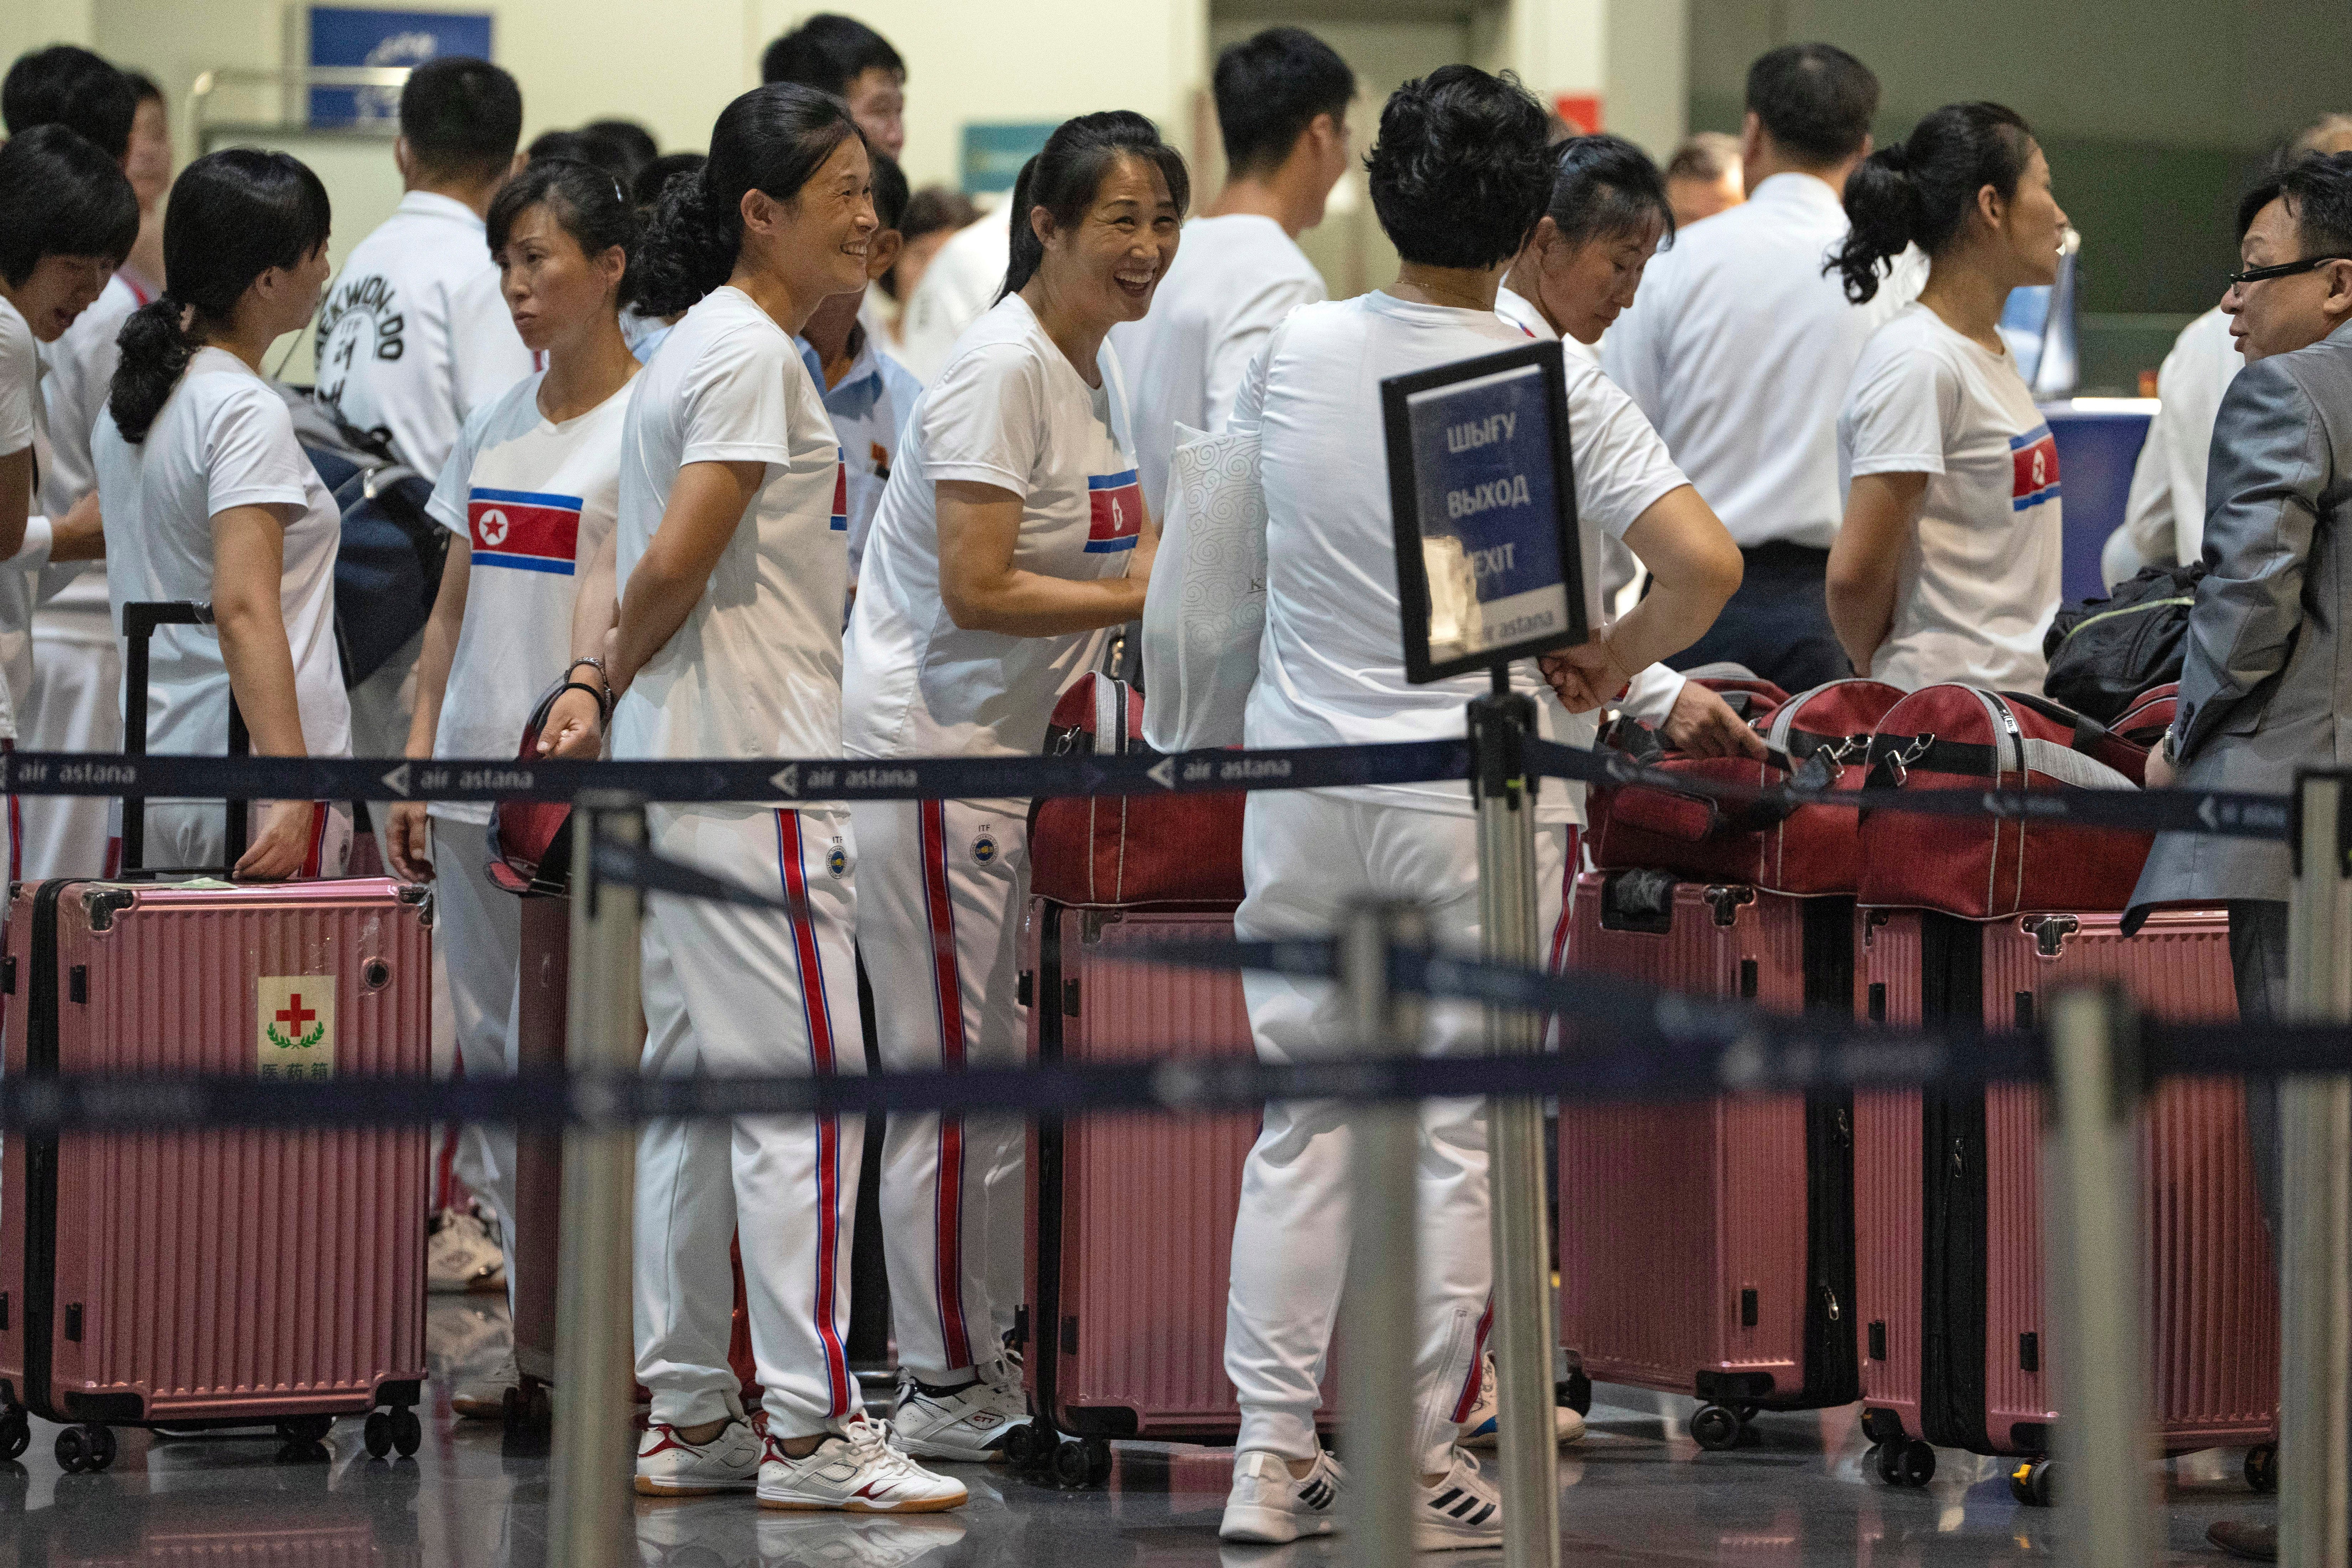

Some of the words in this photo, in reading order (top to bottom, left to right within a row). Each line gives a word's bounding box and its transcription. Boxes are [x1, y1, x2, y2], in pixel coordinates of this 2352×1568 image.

[1447, 474, 1530, 519] ВЫХОД
[1472, 542, 1516, 578] EXIT
[1499, 610, 1554, 639] astana
[17, 759, 48, 782] air
[59, 762, 136, 784] astana
[420, 767, 449, 790] air
[459, 769, 534, 790] astana
[807, 767, 836, 788] air
[845, 767, 918, 788] astana
[1183, 759, 1211, 781] air
[1220, 758, 1292, 780] astana
